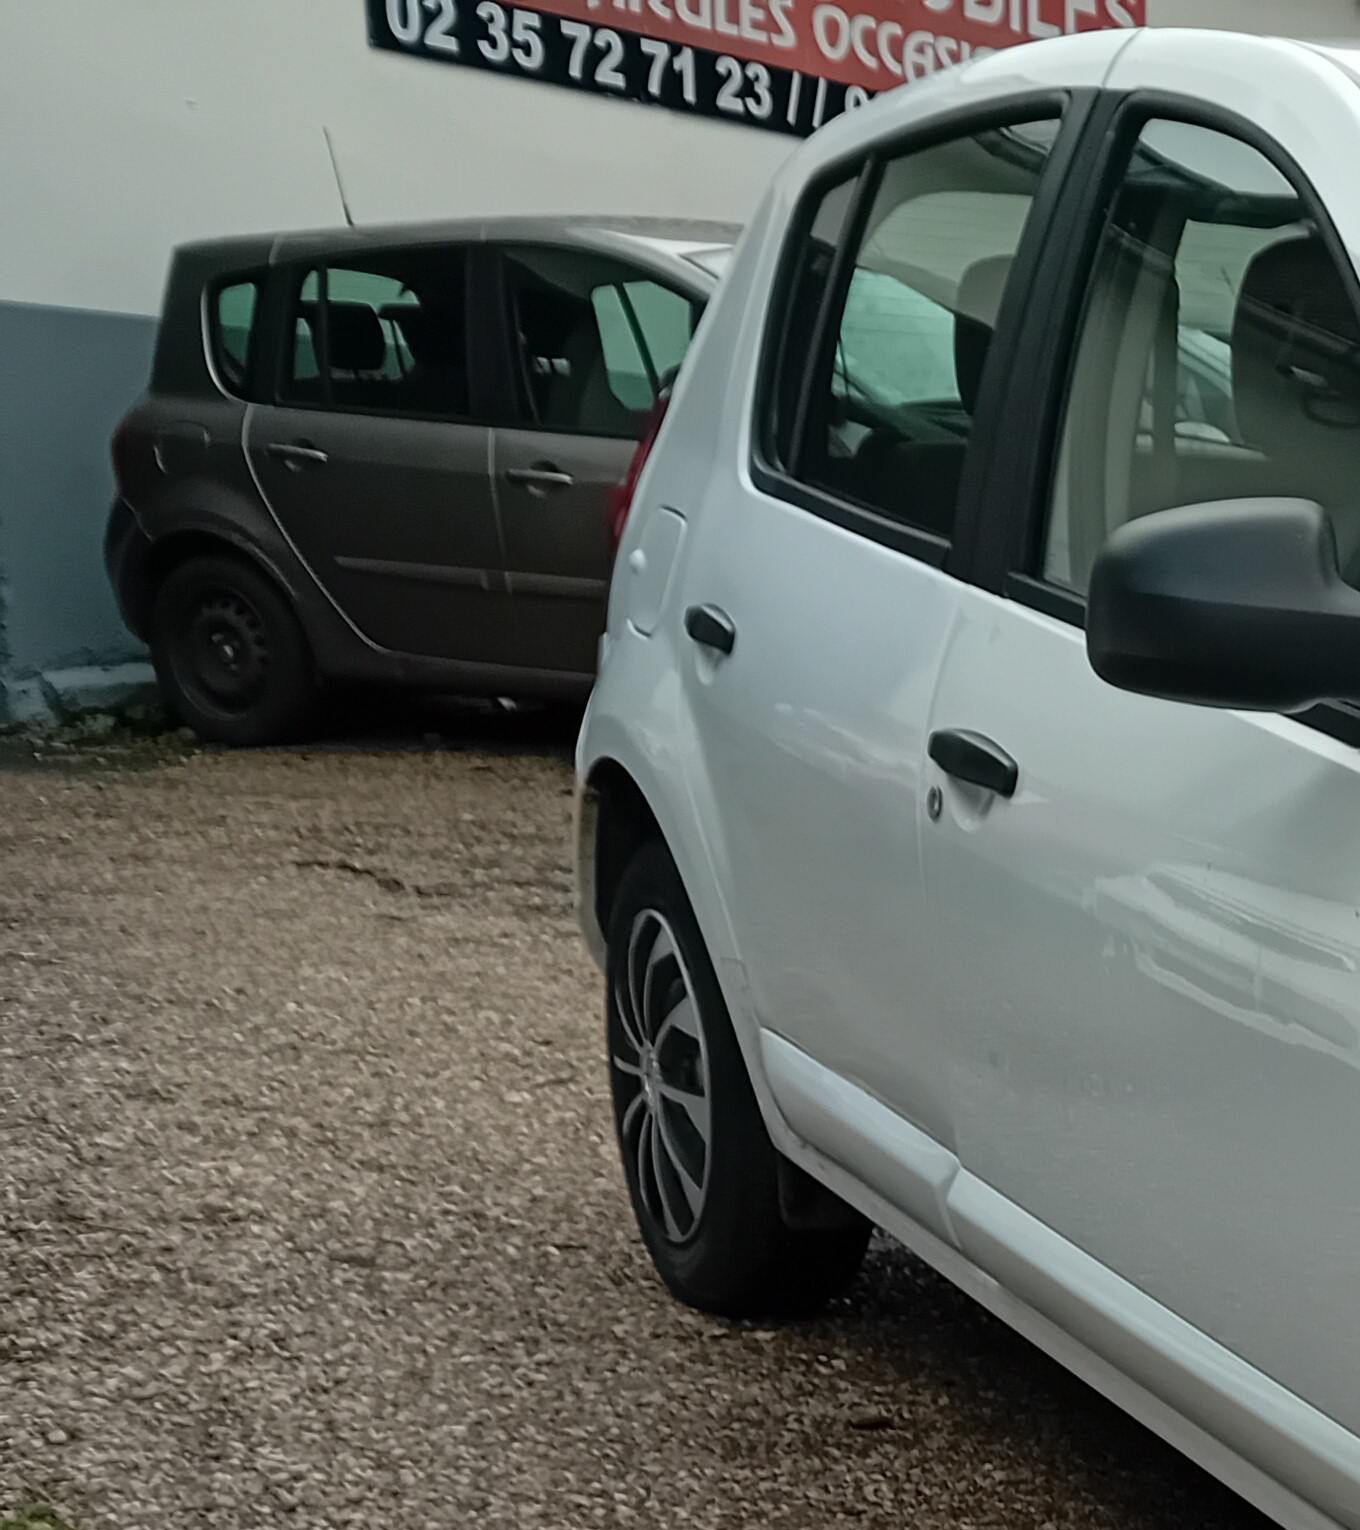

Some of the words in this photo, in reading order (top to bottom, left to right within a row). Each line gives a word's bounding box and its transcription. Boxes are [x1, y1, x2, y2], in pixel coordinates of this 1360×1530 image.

[386, 0, 459, 51] 02
[476, 1, 545, 70] 35
[560, 19, 626, 91] 72
[640, 37, 697, 105] 71
[715, 55, 773, 118] 23
